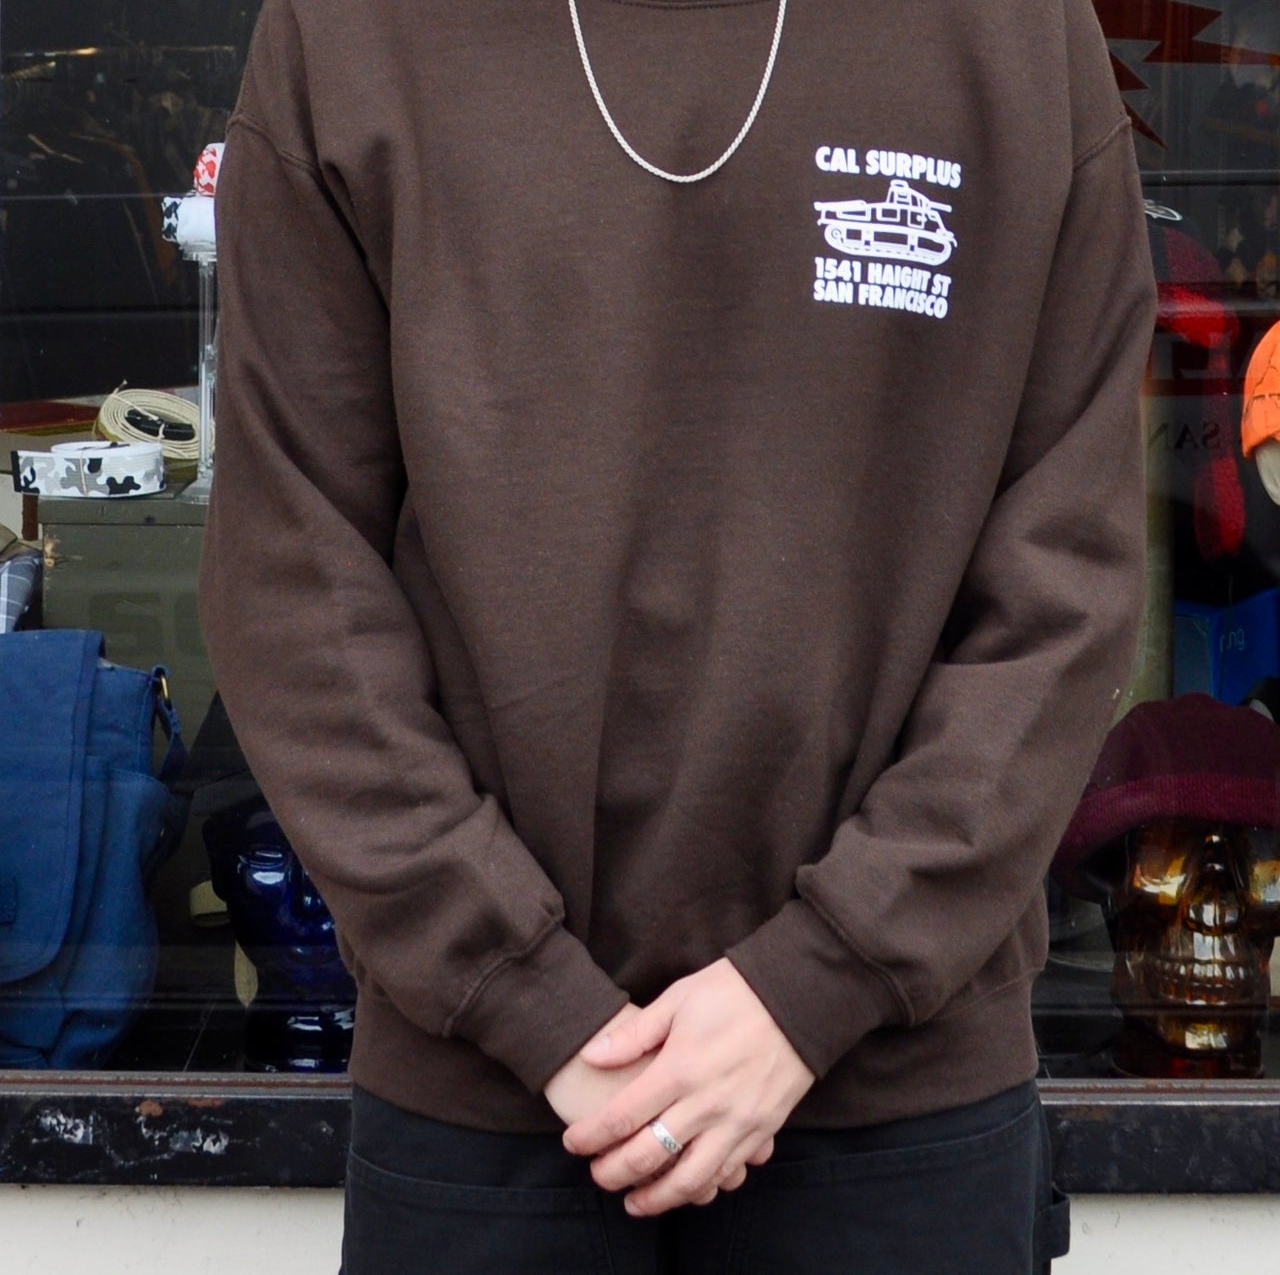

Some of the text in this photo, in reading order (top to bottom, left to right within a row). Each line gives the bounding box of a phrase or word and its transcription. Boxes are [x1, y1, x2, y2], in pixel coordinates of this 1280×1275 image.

[815, 146, 962, 188] CAL SURPLUS
[814, 257, 952, 297] 1541 HAIGHT ST
[813, 279, 949, 319] SAN FRANCISCO
